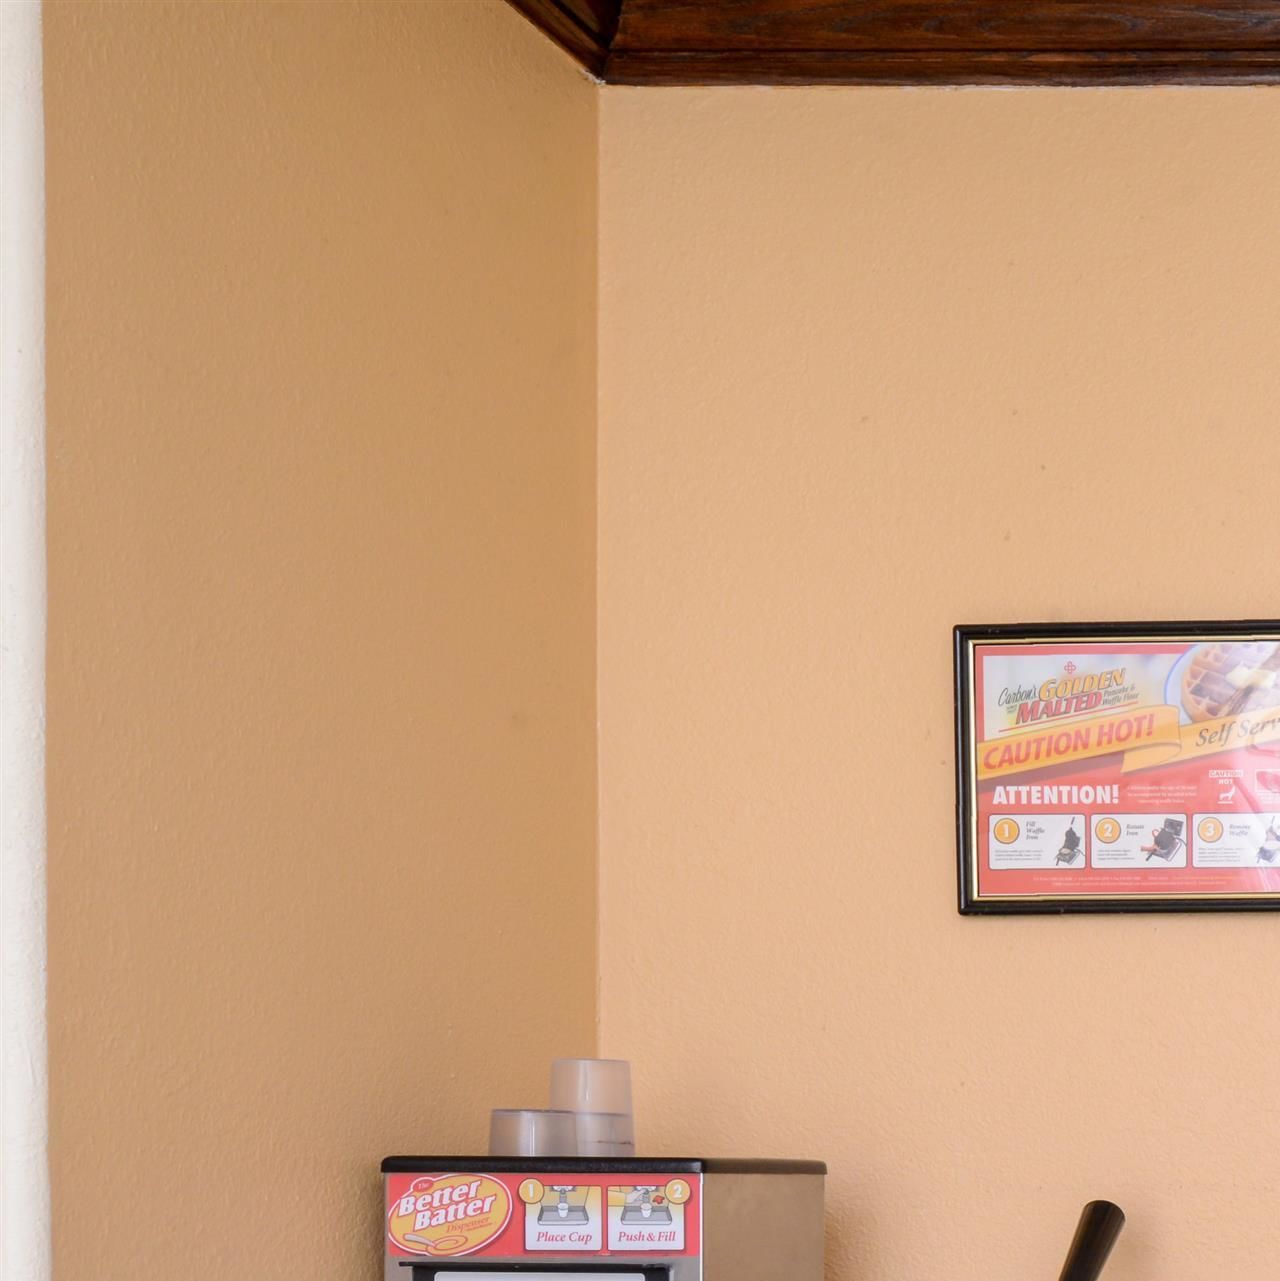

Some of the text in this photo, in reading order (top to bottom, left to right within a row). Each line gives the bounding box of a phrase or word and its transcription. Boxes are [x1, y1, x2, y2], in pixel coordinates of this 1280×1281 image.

[1039, 668, 1127, 701] GOLDEN
[1016, 691, 1103, 725] MALTED
[983, 714, 1156, 771] CAUTION HOT!
[1195, 720, 1236, 748] Self
[992, 784, 1120, 805] ATTENTION!
[1003, 823, 1009, 838] 1
[1103, 823, 1113, 837] 2
[1206, 823, 1215, 837] 3
[398, 1180, 482, 1217] Better
[528, 1183, 534, 1199] 1
[672, 1184, 683, 1199] 2
[414, 1195, 496, 1231] Batter
[536, 1231, 593, 1245] Place Cup
[618, 1231, 677, 1242] Push & Fill
